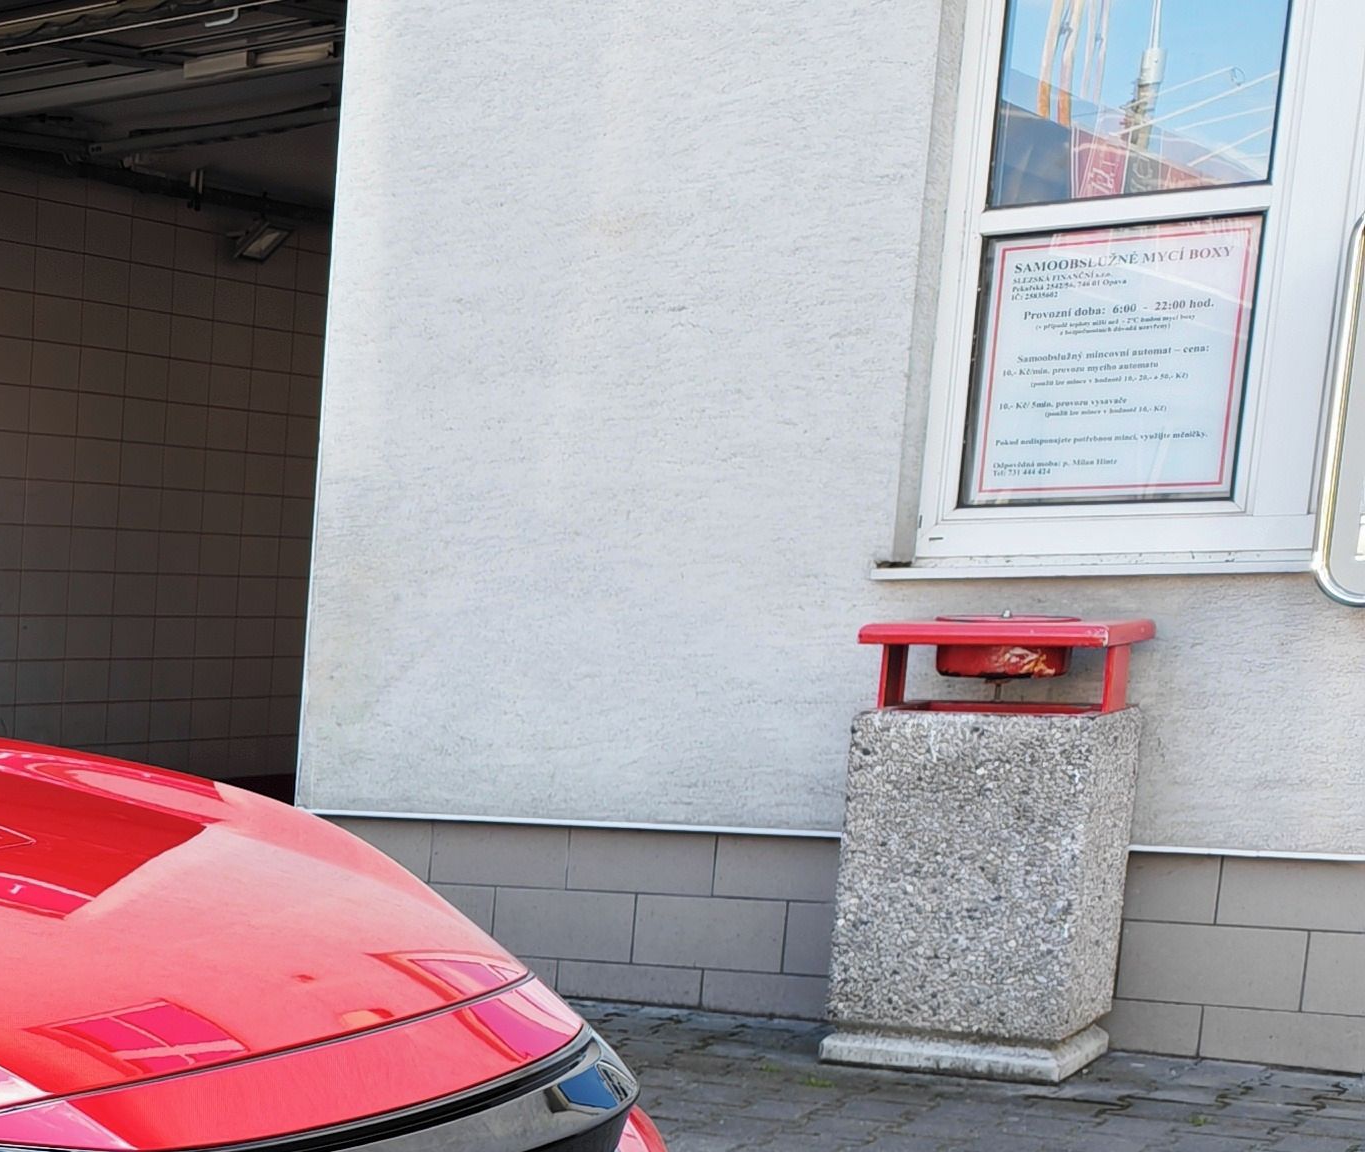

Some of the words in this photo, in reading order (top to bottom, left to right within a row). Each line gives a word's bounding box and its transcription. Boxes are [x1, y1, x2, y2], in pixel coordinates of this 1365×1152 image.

[1014, 250, 1139, 274] SAMOOBSLUŽNÉ
[1142, 246, 1185, 263] MYCÍ
[1189, 246, 1235, 260] BOXY
[1024, 307, 1072, 320] Provozní
[1074, 306, 1106, 317] doba:
[1112, 303, 1137, 314] 6:00
[1154, 300, 1186, 311] 22:00
[1189, 298, 1214, 309] hod.
[1017, 351, 1082, 363] Samoobslužný
[1086, 348, 1129, 359] mincovní
[1132, 347, 1172, 357] automat
[1183, 345, 1209, 353] cena:
[1052, 366, 1085, 375] provozu
[1118, 361, 1159, 370] automatu
[1055, 399, 1088, 408] provozu
